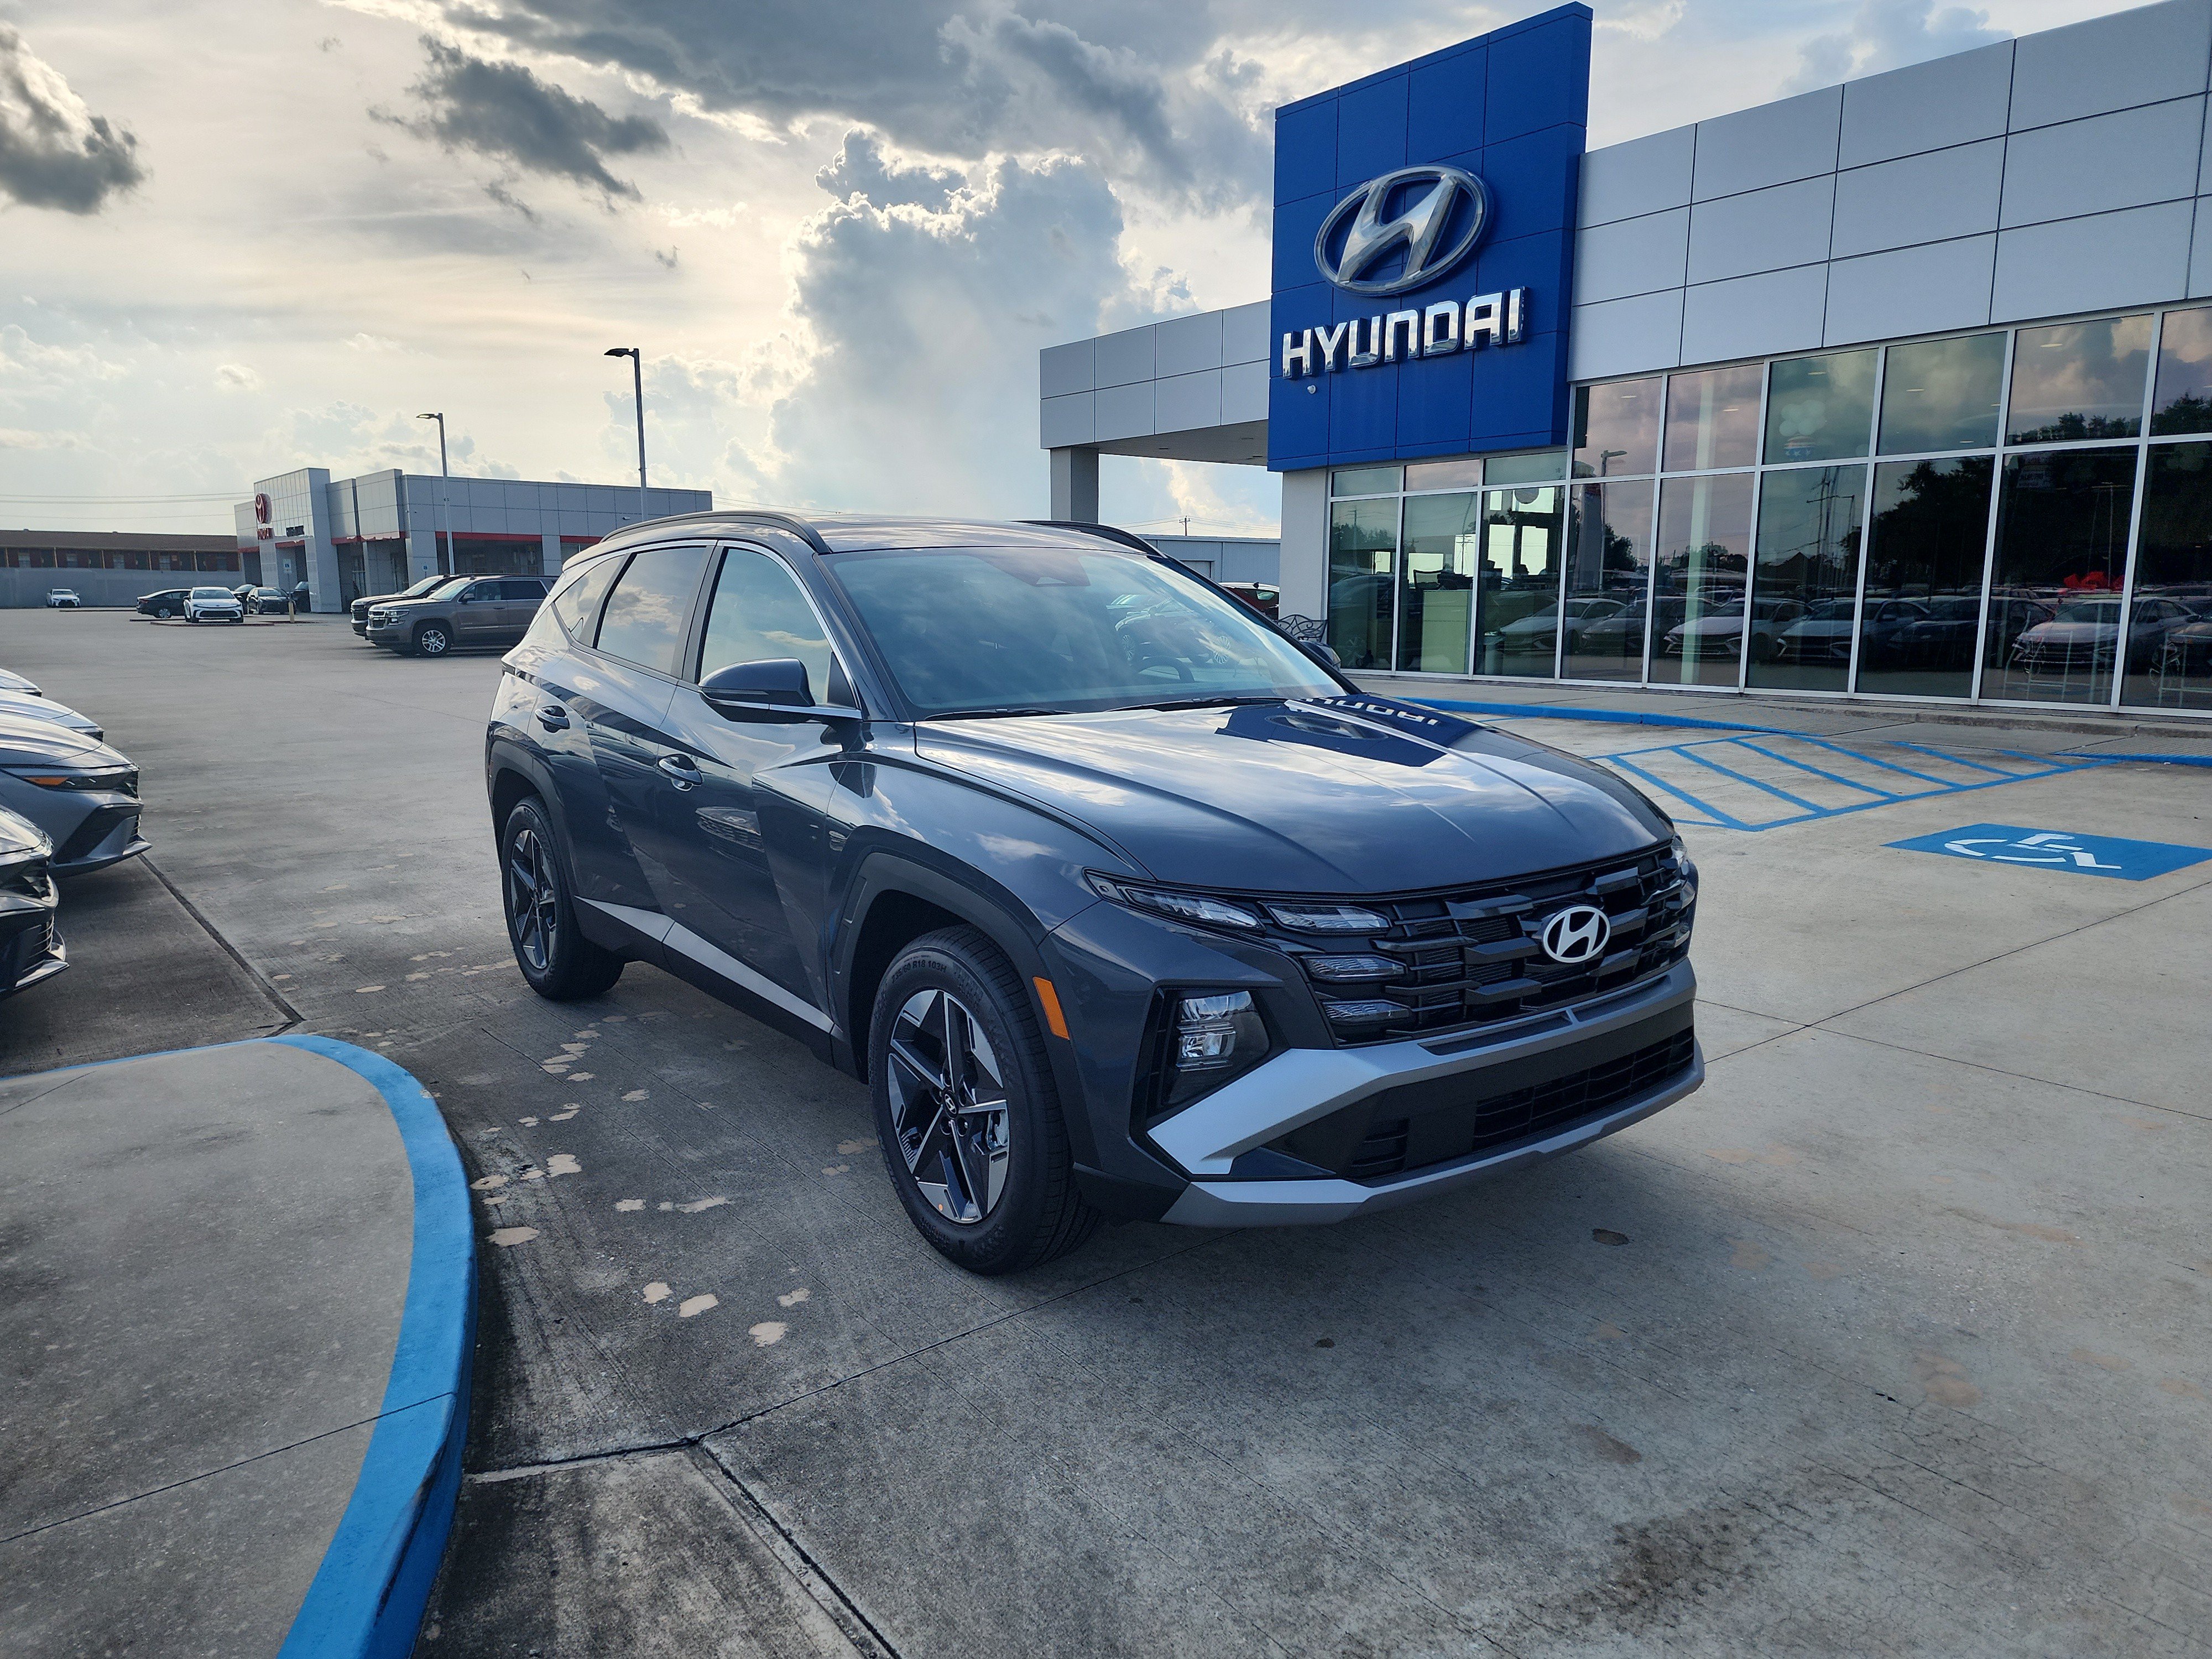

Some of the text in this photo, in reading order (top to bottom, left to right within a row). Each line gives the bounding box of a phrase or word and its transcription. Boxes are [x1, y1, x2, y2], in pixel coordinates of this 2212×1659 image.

[1282, 286, 1525, 378] HYUNDAI
[912, 959, 926, 969] R18
[928, 961, 947, 973] 103H
